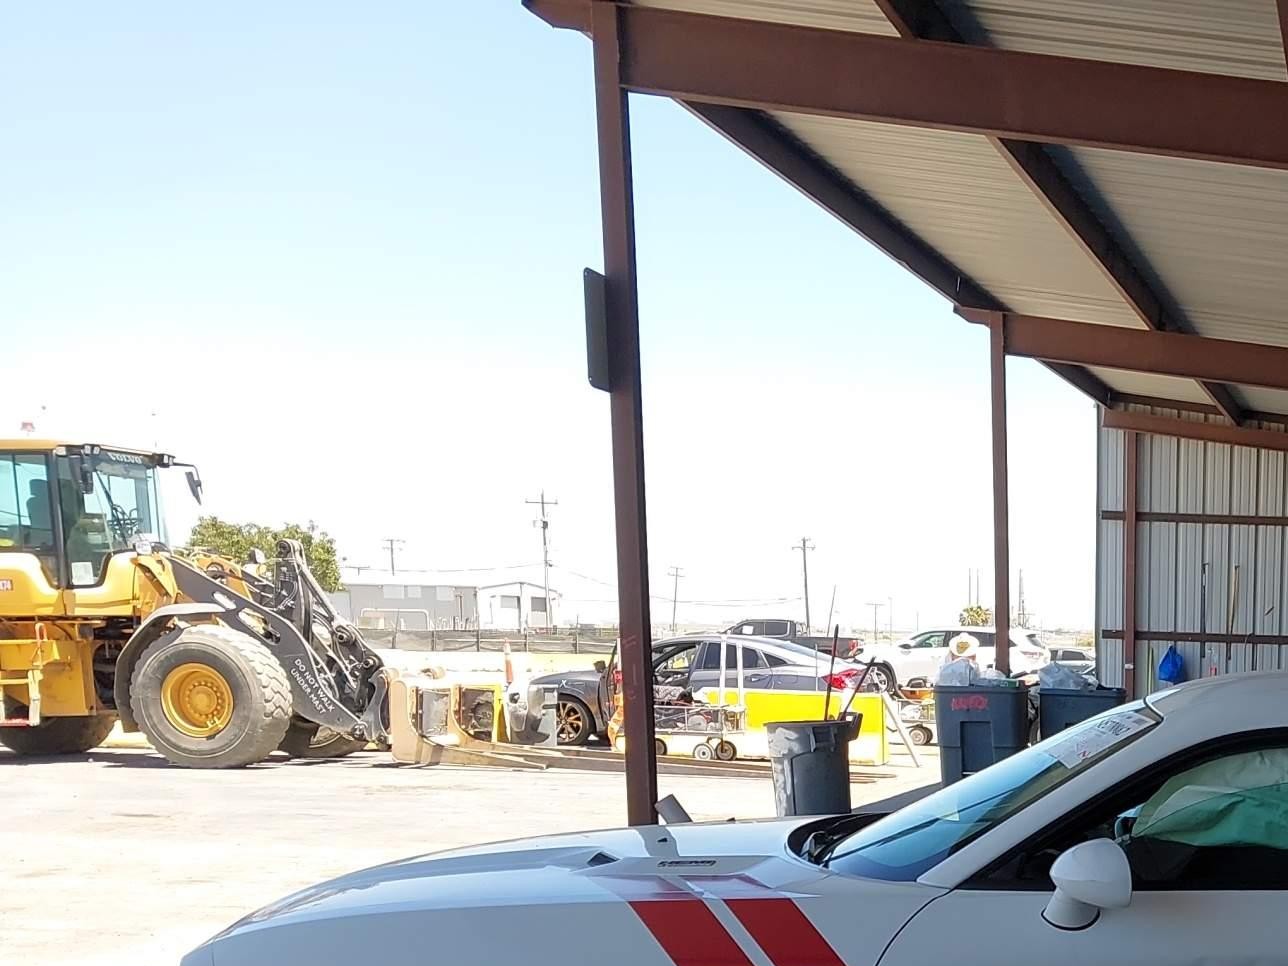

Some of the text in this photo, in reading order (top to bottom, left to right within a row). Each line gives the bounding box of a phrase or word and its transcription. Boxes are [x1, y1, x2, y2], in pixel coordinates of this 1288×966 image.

[290, 668, 327, 714] UNDER MAST
[294, 658, 335, 712] DO NOT WALK
